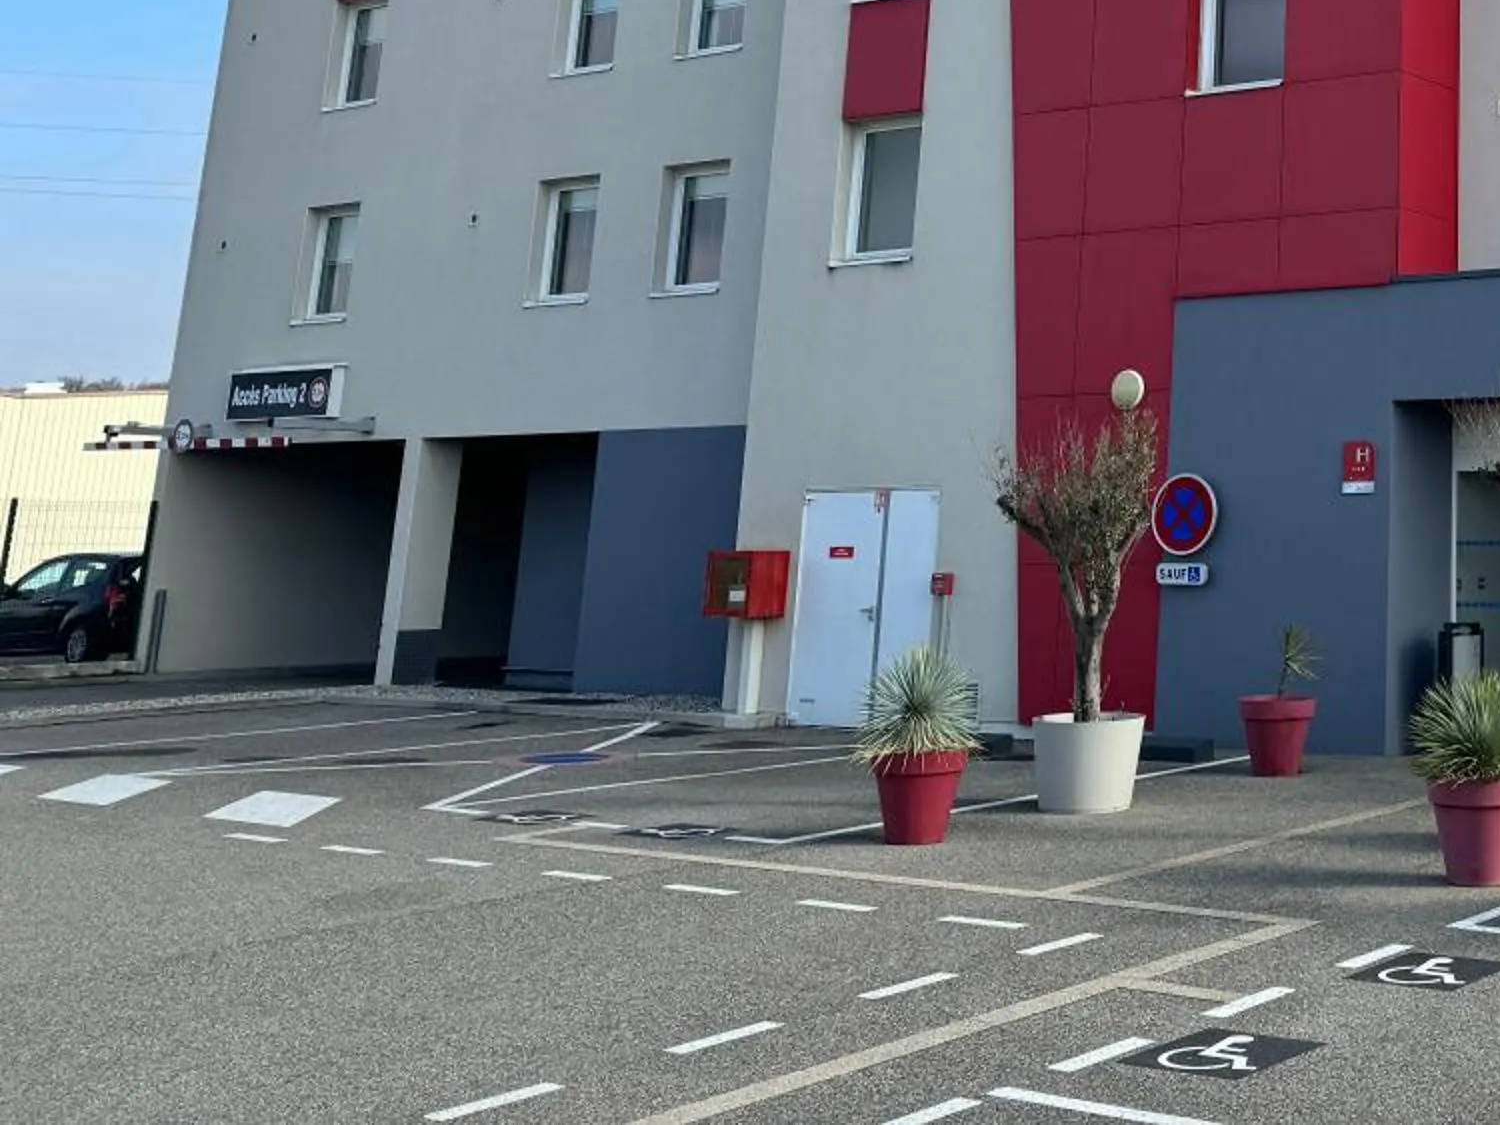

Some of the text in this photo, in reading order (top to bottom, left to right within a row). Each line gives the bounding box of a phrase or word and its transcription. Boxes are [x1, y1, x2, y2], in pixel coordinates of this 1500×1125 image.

[232, 385, 261, 406] Accès
[262, 383, 298, 408] Parking
[299, 382, 307, 403] 2
[1356, 447, 1369, 463] H
[1159, 567, 1187, 580] SAUF
